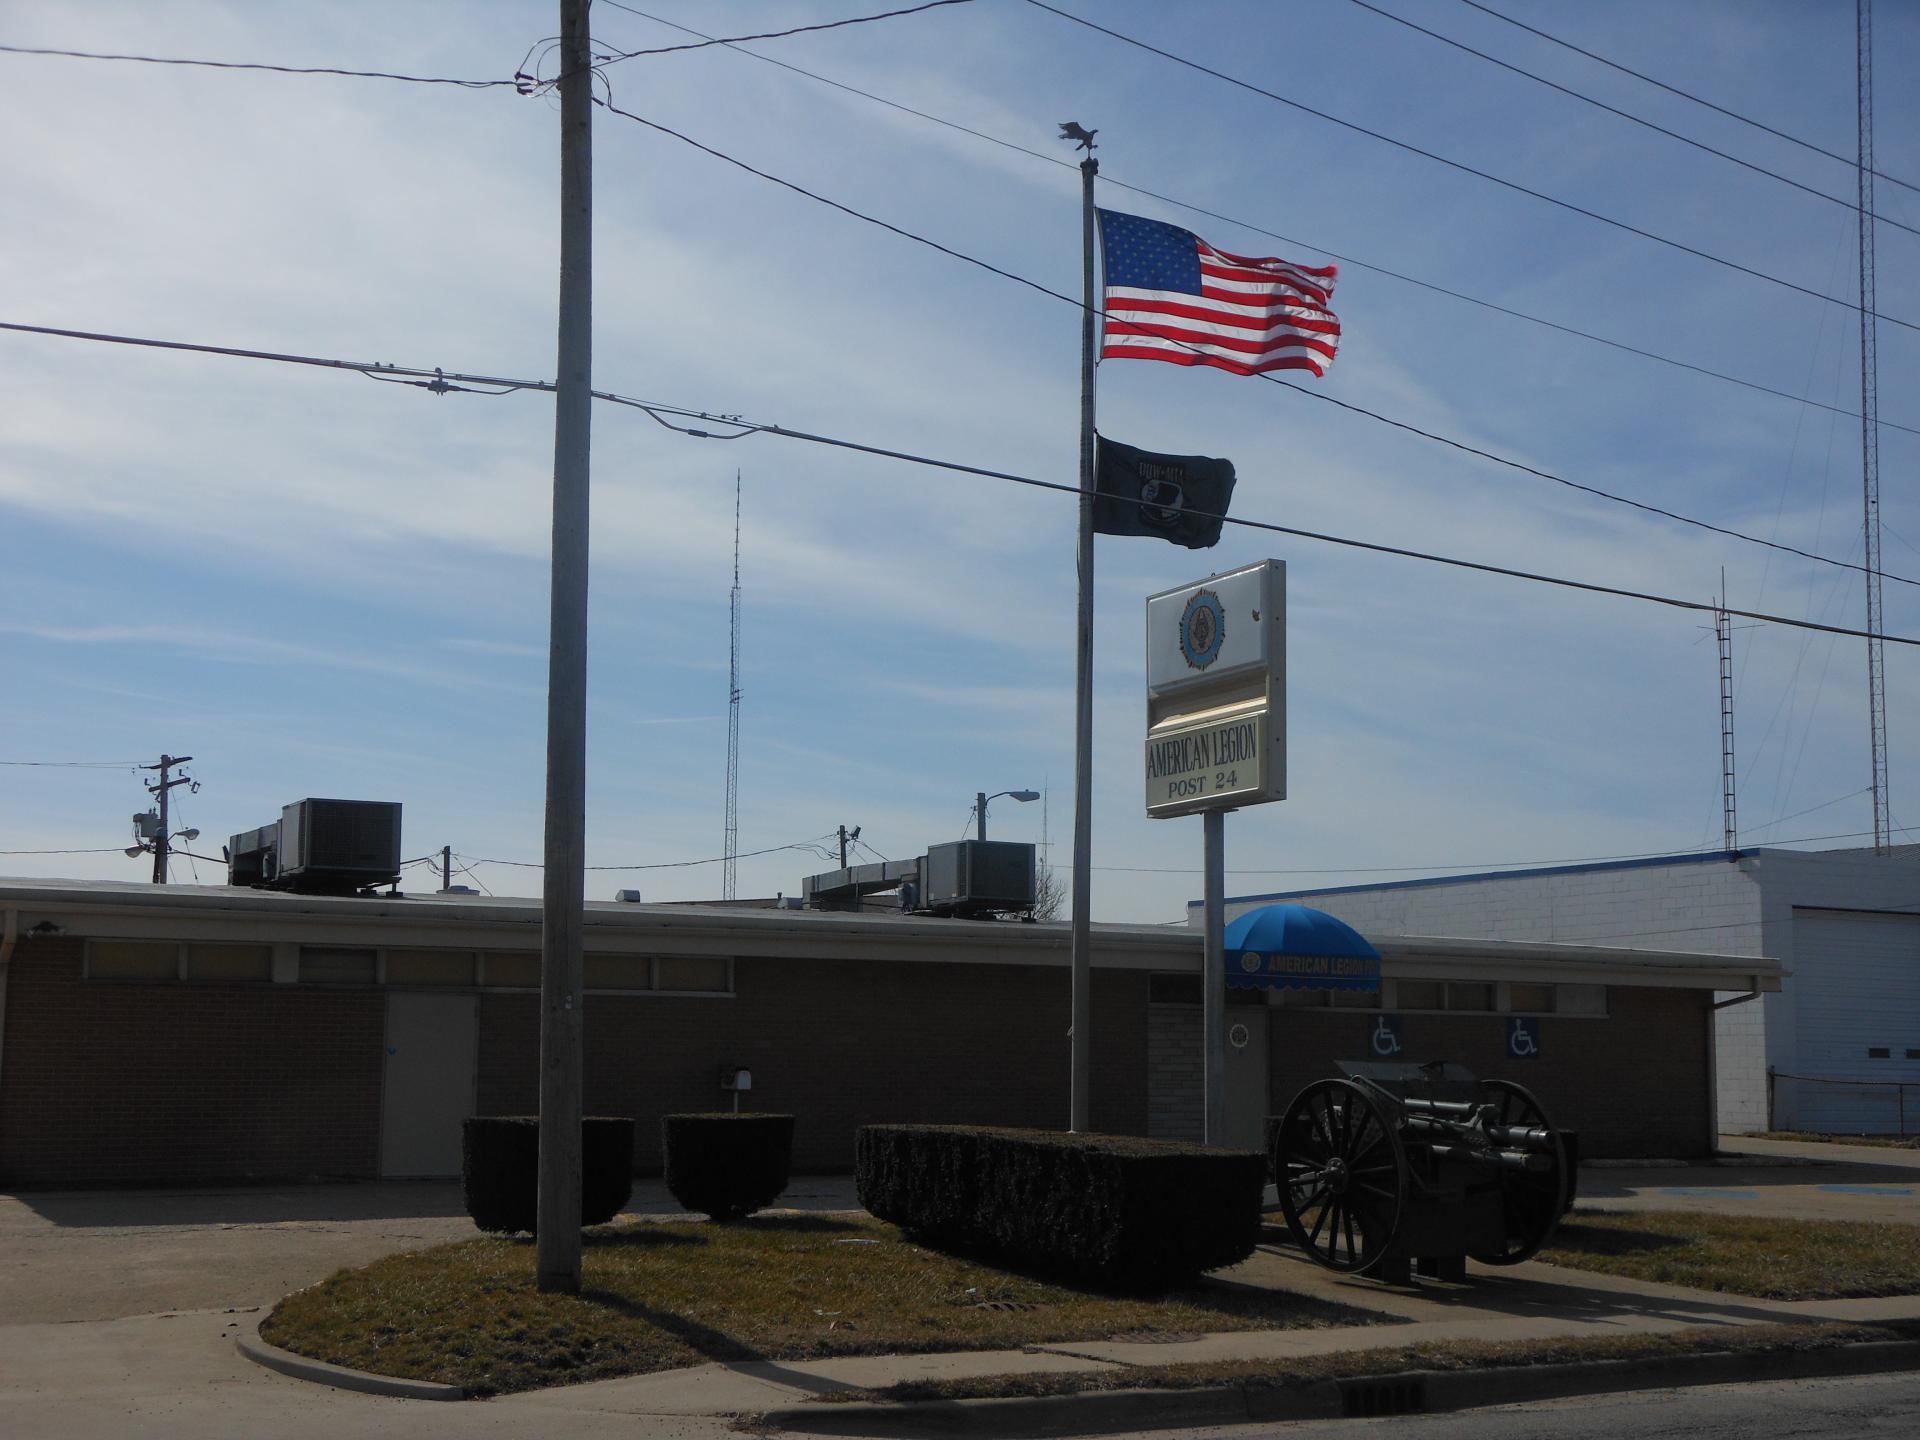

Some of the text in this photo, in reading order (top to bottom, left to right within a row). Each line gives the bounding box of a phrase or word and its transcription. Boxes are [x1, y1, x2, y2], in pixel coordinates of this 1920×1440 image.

[1147, 722, 1256, 779] AMERICAN LEGION
[1168, 770, 1238, 799] POST 24
[1267, 955, 1328, 975] AMERICAN
